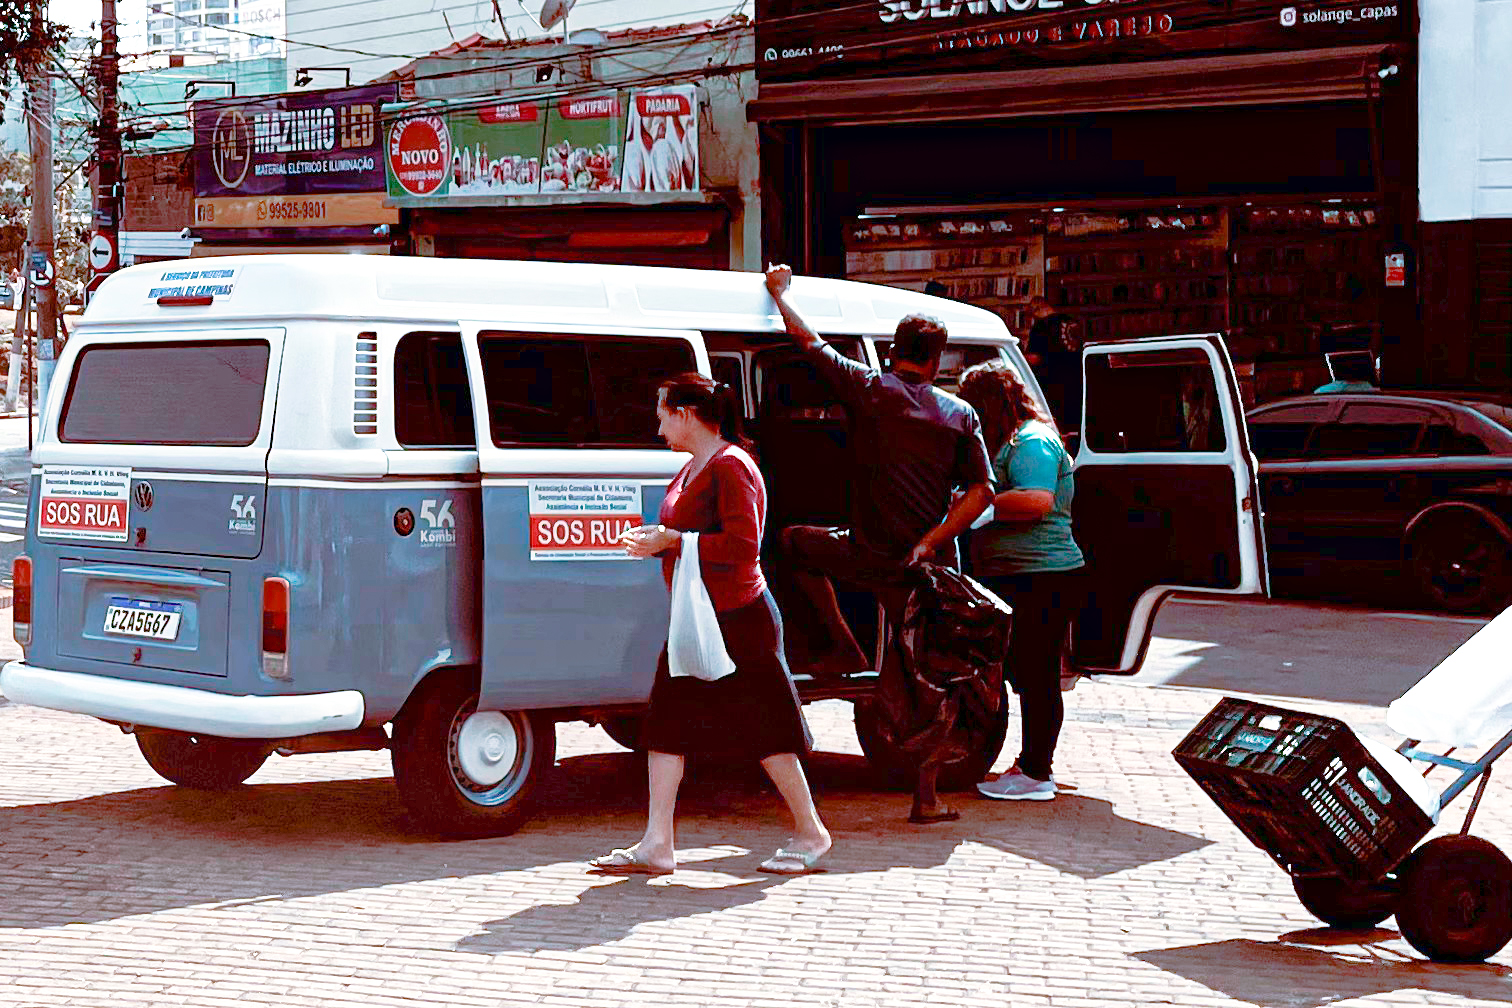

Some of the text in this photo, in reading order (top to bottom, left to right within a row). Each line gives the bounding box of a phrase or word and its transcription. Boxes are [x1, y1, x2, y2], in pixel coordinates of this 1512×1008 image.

[243, 8, 281, 23] OSCH
[1302, 5, 1398, 24] solange_capas
[645, 98, 681, 113] PADARIA
[254, 104, 375, 153] MAZINHO LED
[254, 156, 375, 176] MATERIAL ELÉTRICO E ILUMINAÇÃO
[401, 149, 439, 165] NOVO
[195, 284, 233, 296] CAMPINAS
[46, 501, 120, 527] SOS RUA
[231, 494, 256, 518] 56
[420, 499, 455, 528] 56
[420, 529, 456, 542] Kombi
[538, 519, 584, 545] SOS
[111, 609, 171, 635] CZA5G67
